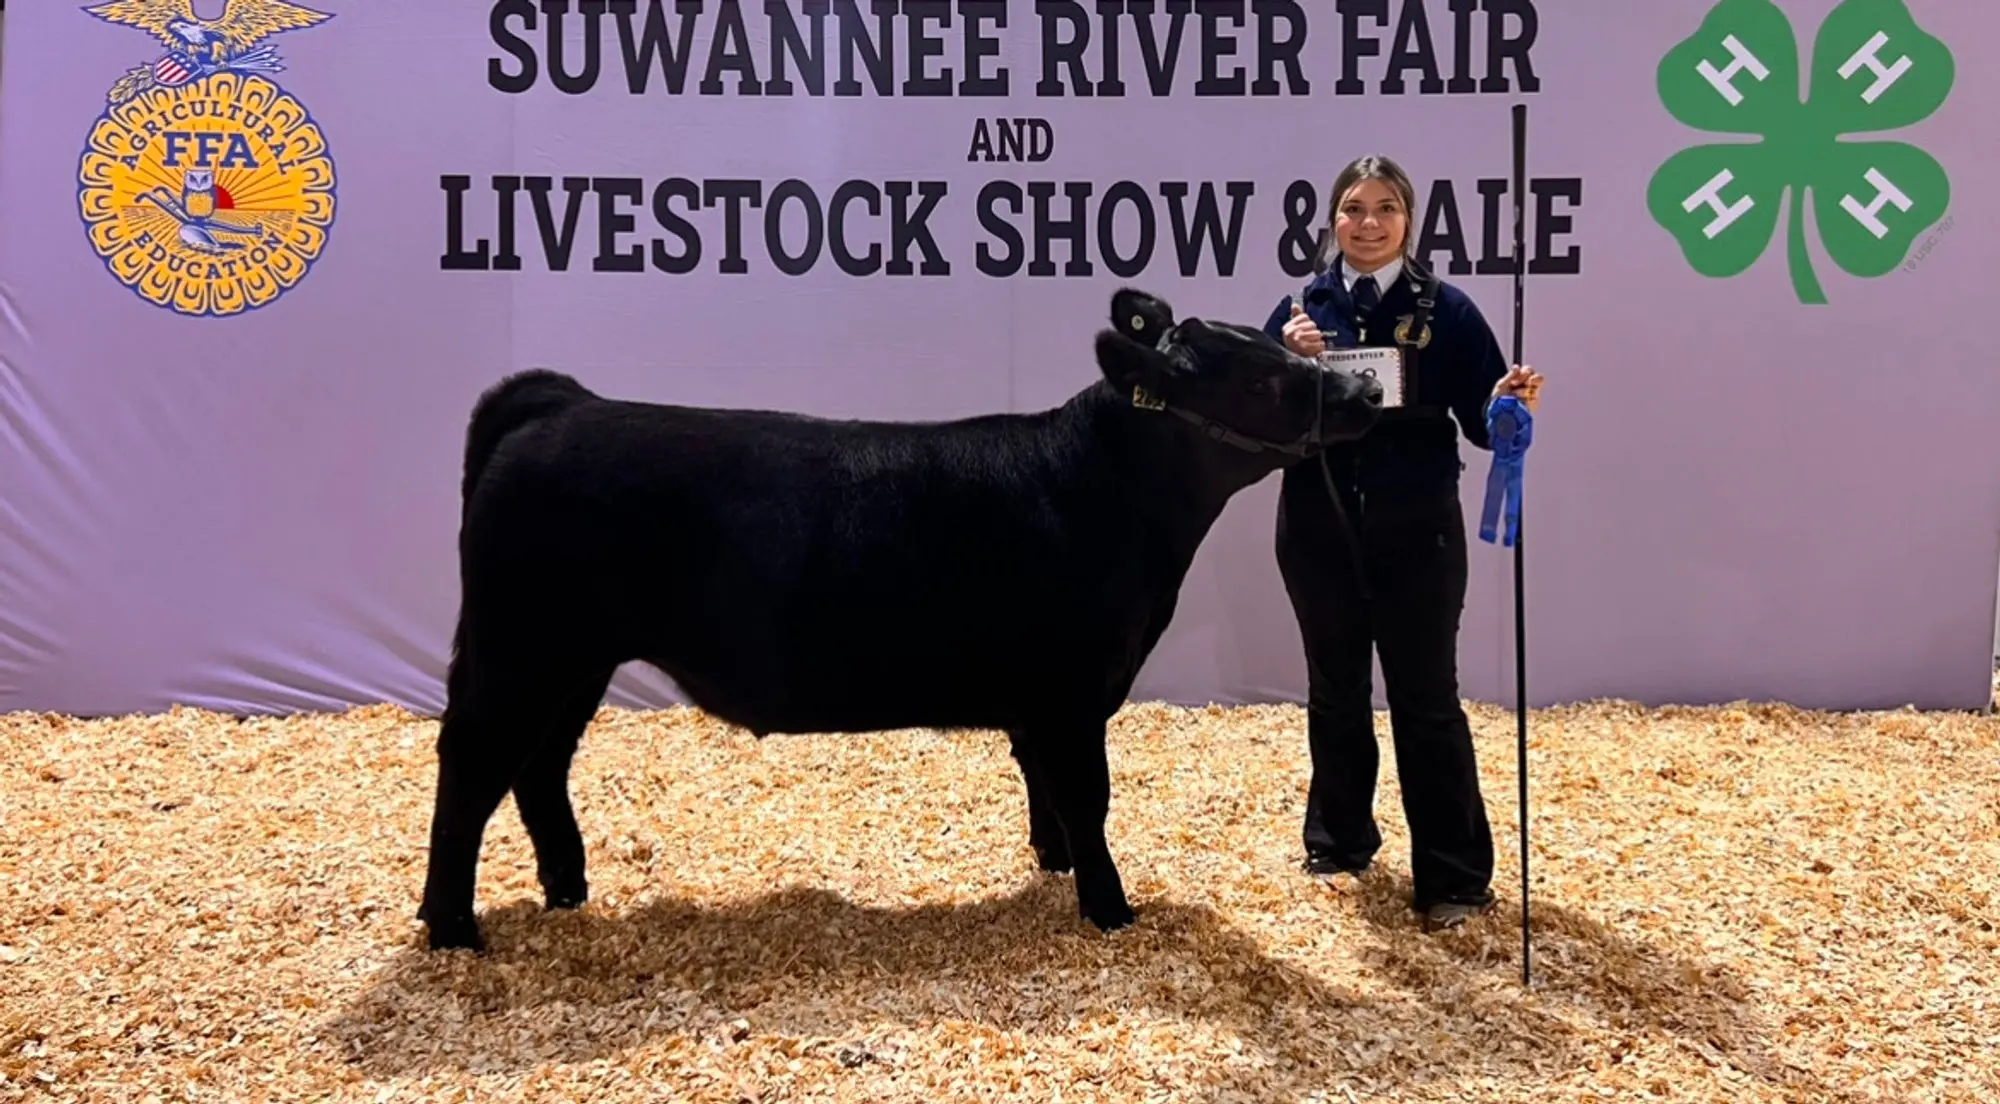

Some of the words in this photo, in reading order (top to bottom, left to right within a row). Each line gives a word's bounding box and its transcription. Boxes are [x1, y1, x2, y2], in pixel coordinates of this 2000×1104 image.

[487, 0, 1010, 96] SUWANNEE
[1035, 0, 1310, 97] RIVER
[1335, 0, 1541, 95] FAIR
[1695, 33, 1770, 107] H
[1836, 30, 1913, 104] H
[119, 101, 295, 174] AGRICULTURAL
[162, 131, 259, 169] FFA
[967, 118, 1054, 163] AND
[440, 175, 951, 276] LIVESTOCK
[975, 180, 1254, 278] SHOW
[1414, 177, 1582, 275] ALE
[1681, 168, 1755, 240] H
[1839, 167, 1914, 240] H
[134, 231, 283, 279] EDUCATION
[1913, 235, 1938, 262] USC
